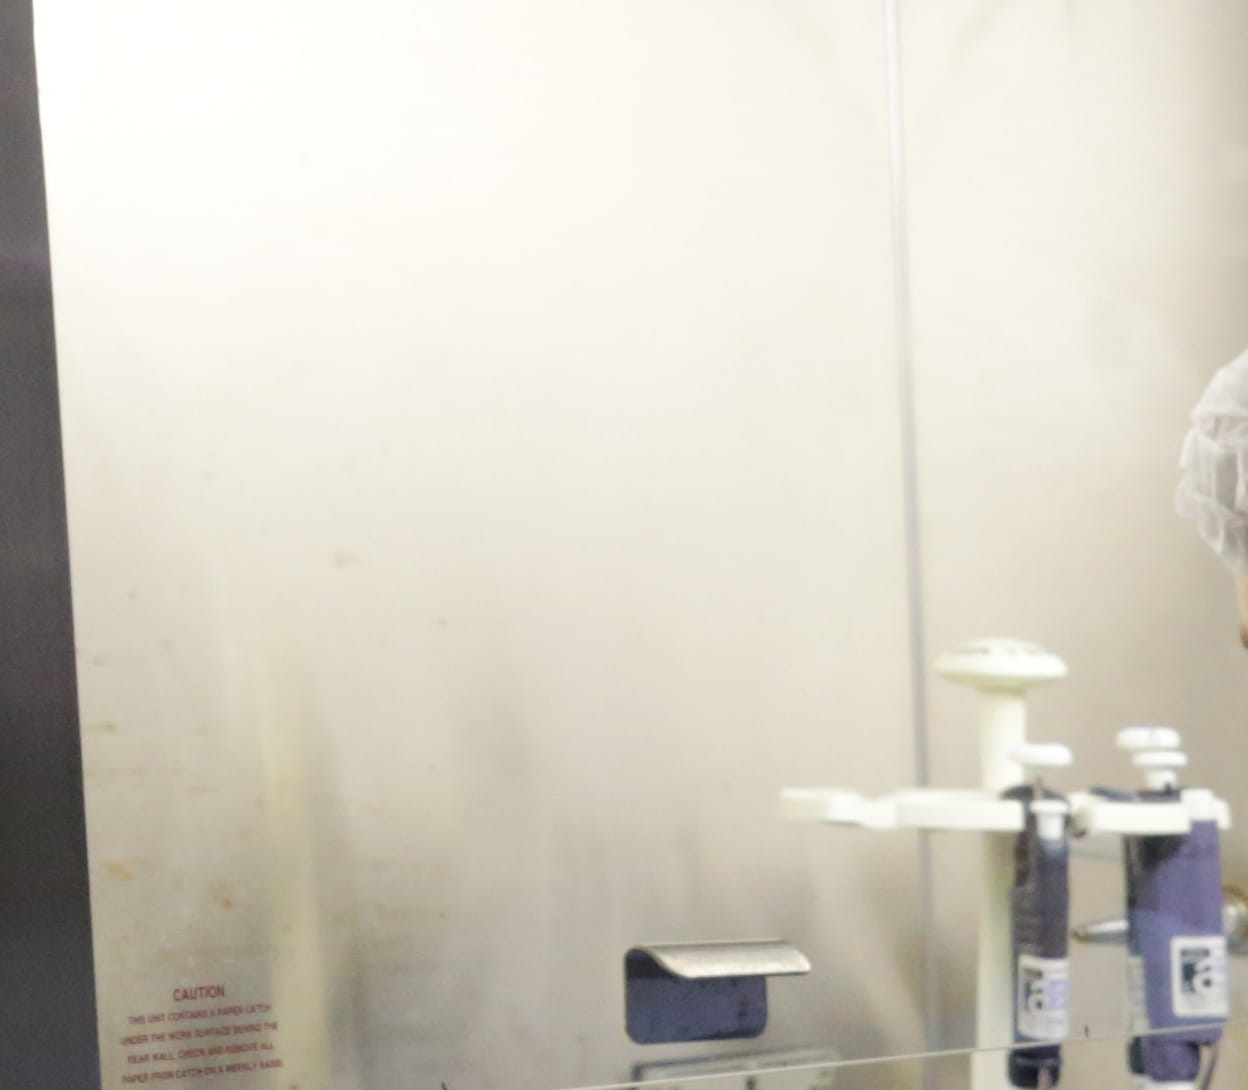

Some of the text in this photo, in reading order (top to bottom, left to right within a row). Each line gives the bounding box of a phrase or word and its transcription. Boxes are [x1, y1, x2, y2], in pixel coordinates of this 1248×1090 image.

[173, 985, 225, 1002] CAUTION
[150, 1033, 165, 1042] THE
[263, 1021, 278, 1032] THE
